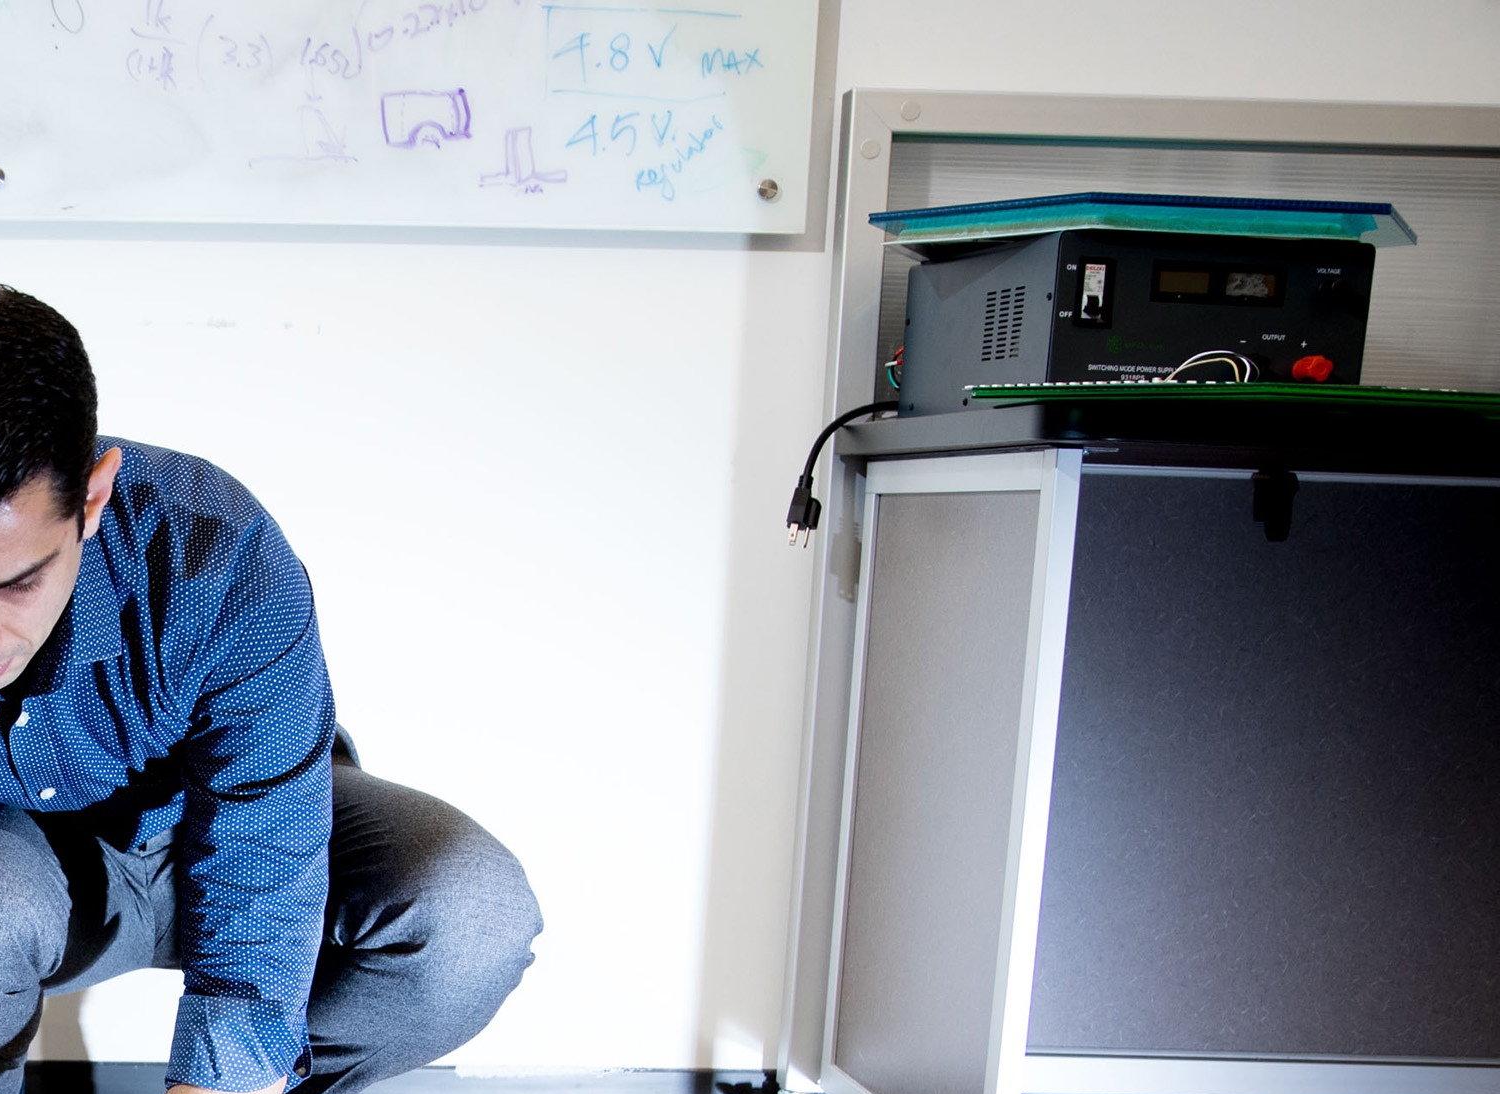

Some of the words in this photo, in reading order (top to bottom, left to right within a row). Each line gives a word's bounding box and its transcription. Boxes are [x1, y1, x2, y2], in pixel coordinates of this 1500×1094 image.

[700, 47, 765, 79] MAX
[1066, 263, 1078, 271] ON
[1316, 267, 1342, 275] VOLTAGE
[1261, 333, 1286, 341] OUTPUT
[1087, 363, 1119, 373] SWITCHING
[1119, 364, 1136, 373] MODE
[1136, 365, 1157, 374] POWER
